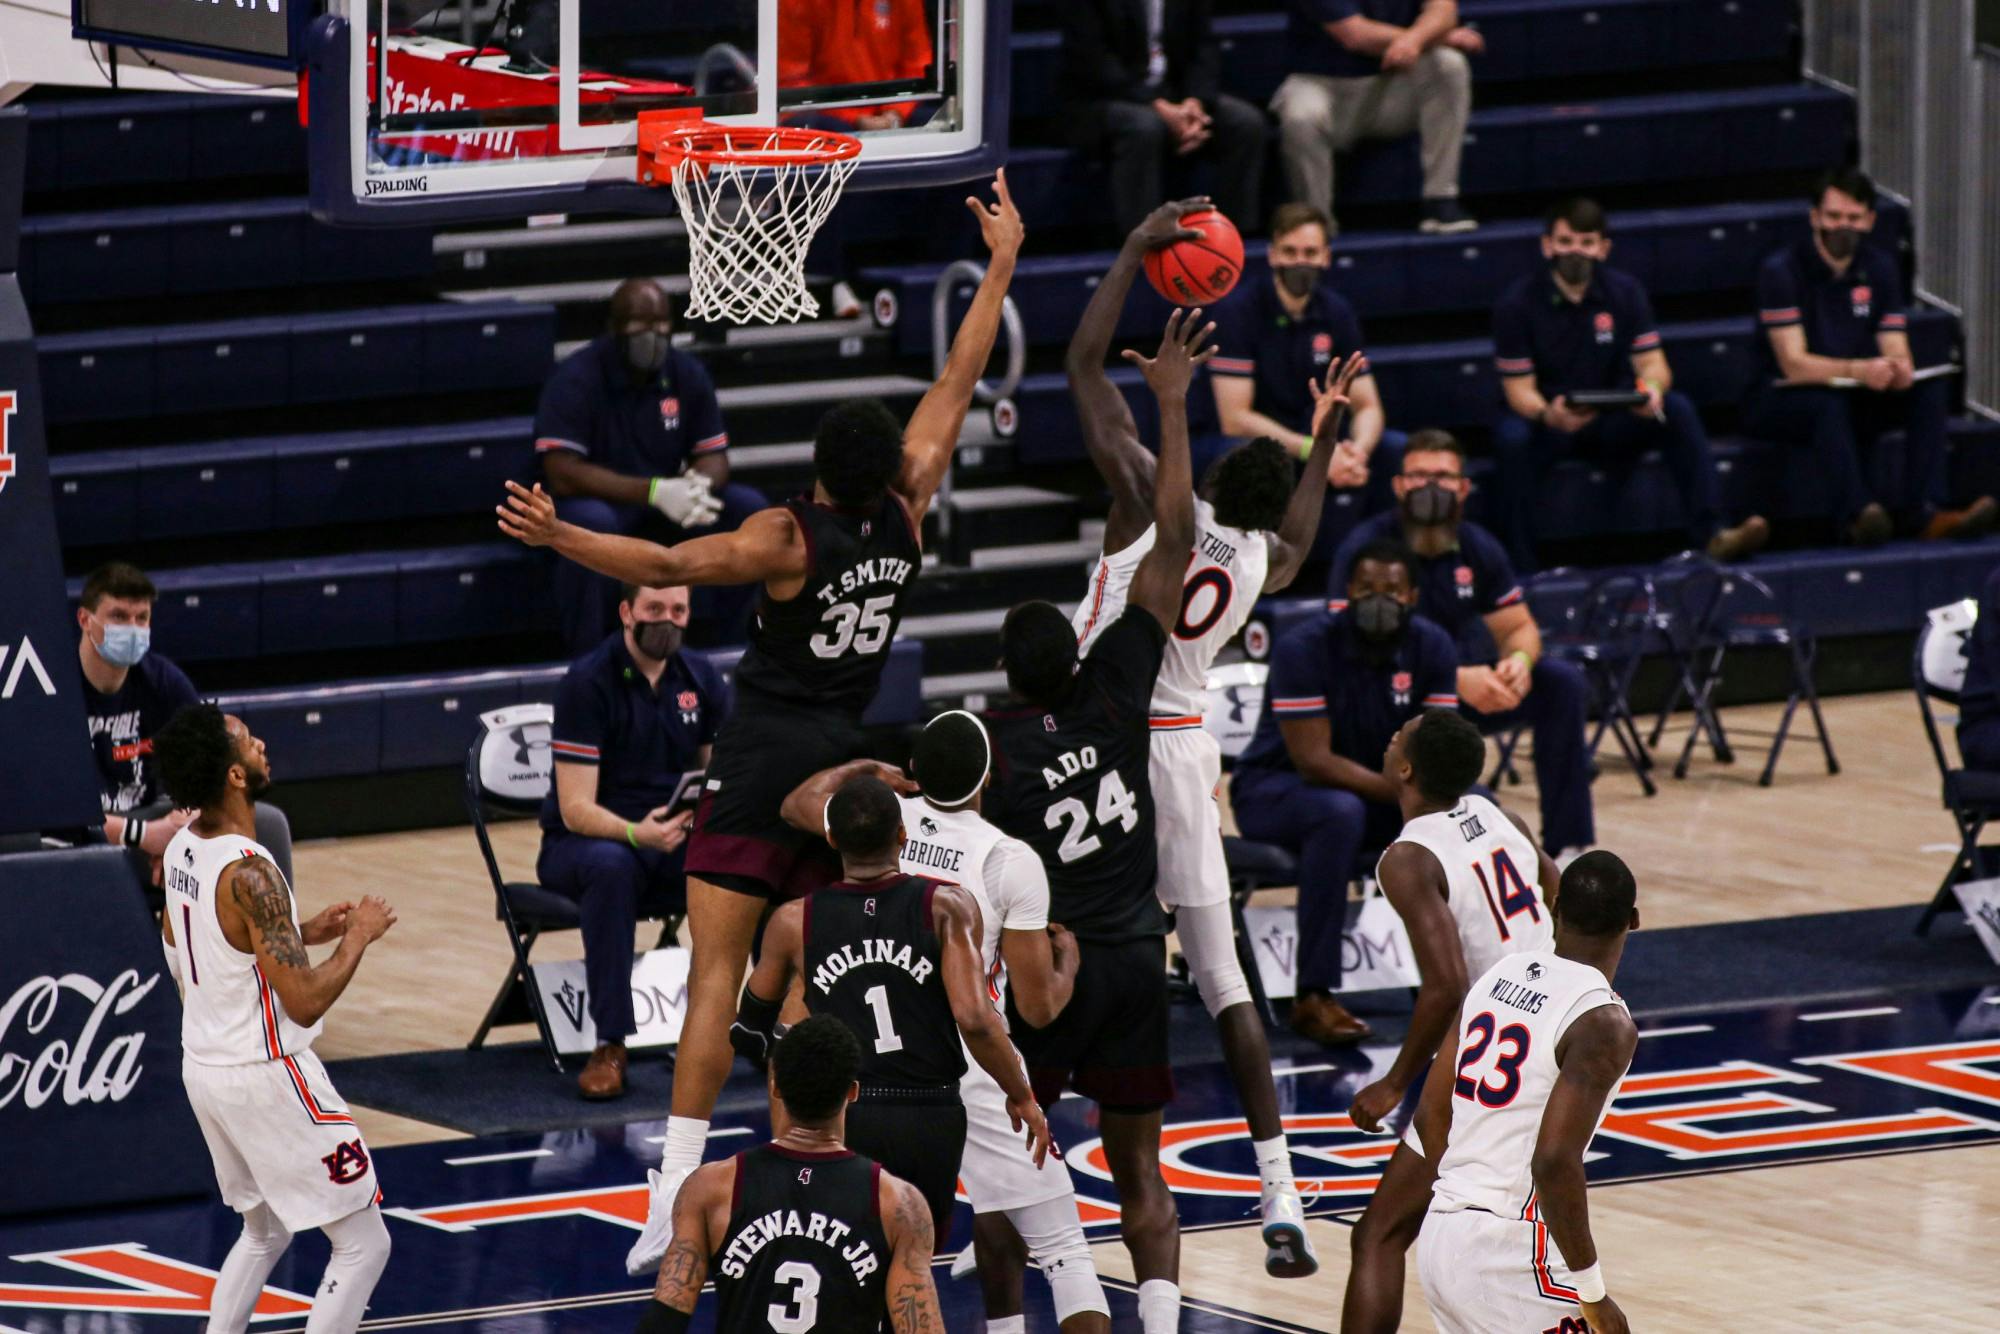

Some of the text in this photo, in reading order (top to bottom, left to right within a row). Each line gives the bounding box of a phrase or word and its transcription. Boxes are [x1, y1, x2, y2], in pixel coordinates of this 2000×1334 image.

[365, 175, 428, 196] SPALDING
[816, 557, 913, 605] T.SMITH
[1200, 531, 1237, 568] THOR
[809, 593, 896, 658] 35
[1042, 745, 1098, 791] ADO
[1043, 769, 1138, 864] 24
[168, 865, 200, 902] JOHNSON
[1471, 847, 1541, 944] 14
[182, 903, 199, 986] 1
[812, 938, 934, 995] MOLINAR
[864, 984, 904, 1054] 1
[1488, 977, 1549, 1015] WILLIAMS
[1454, 1010, 1532, 1109] 23
[720, 1209, 879, 1287] STEWART JR.
[767, 1261, 822, 1334] 3
